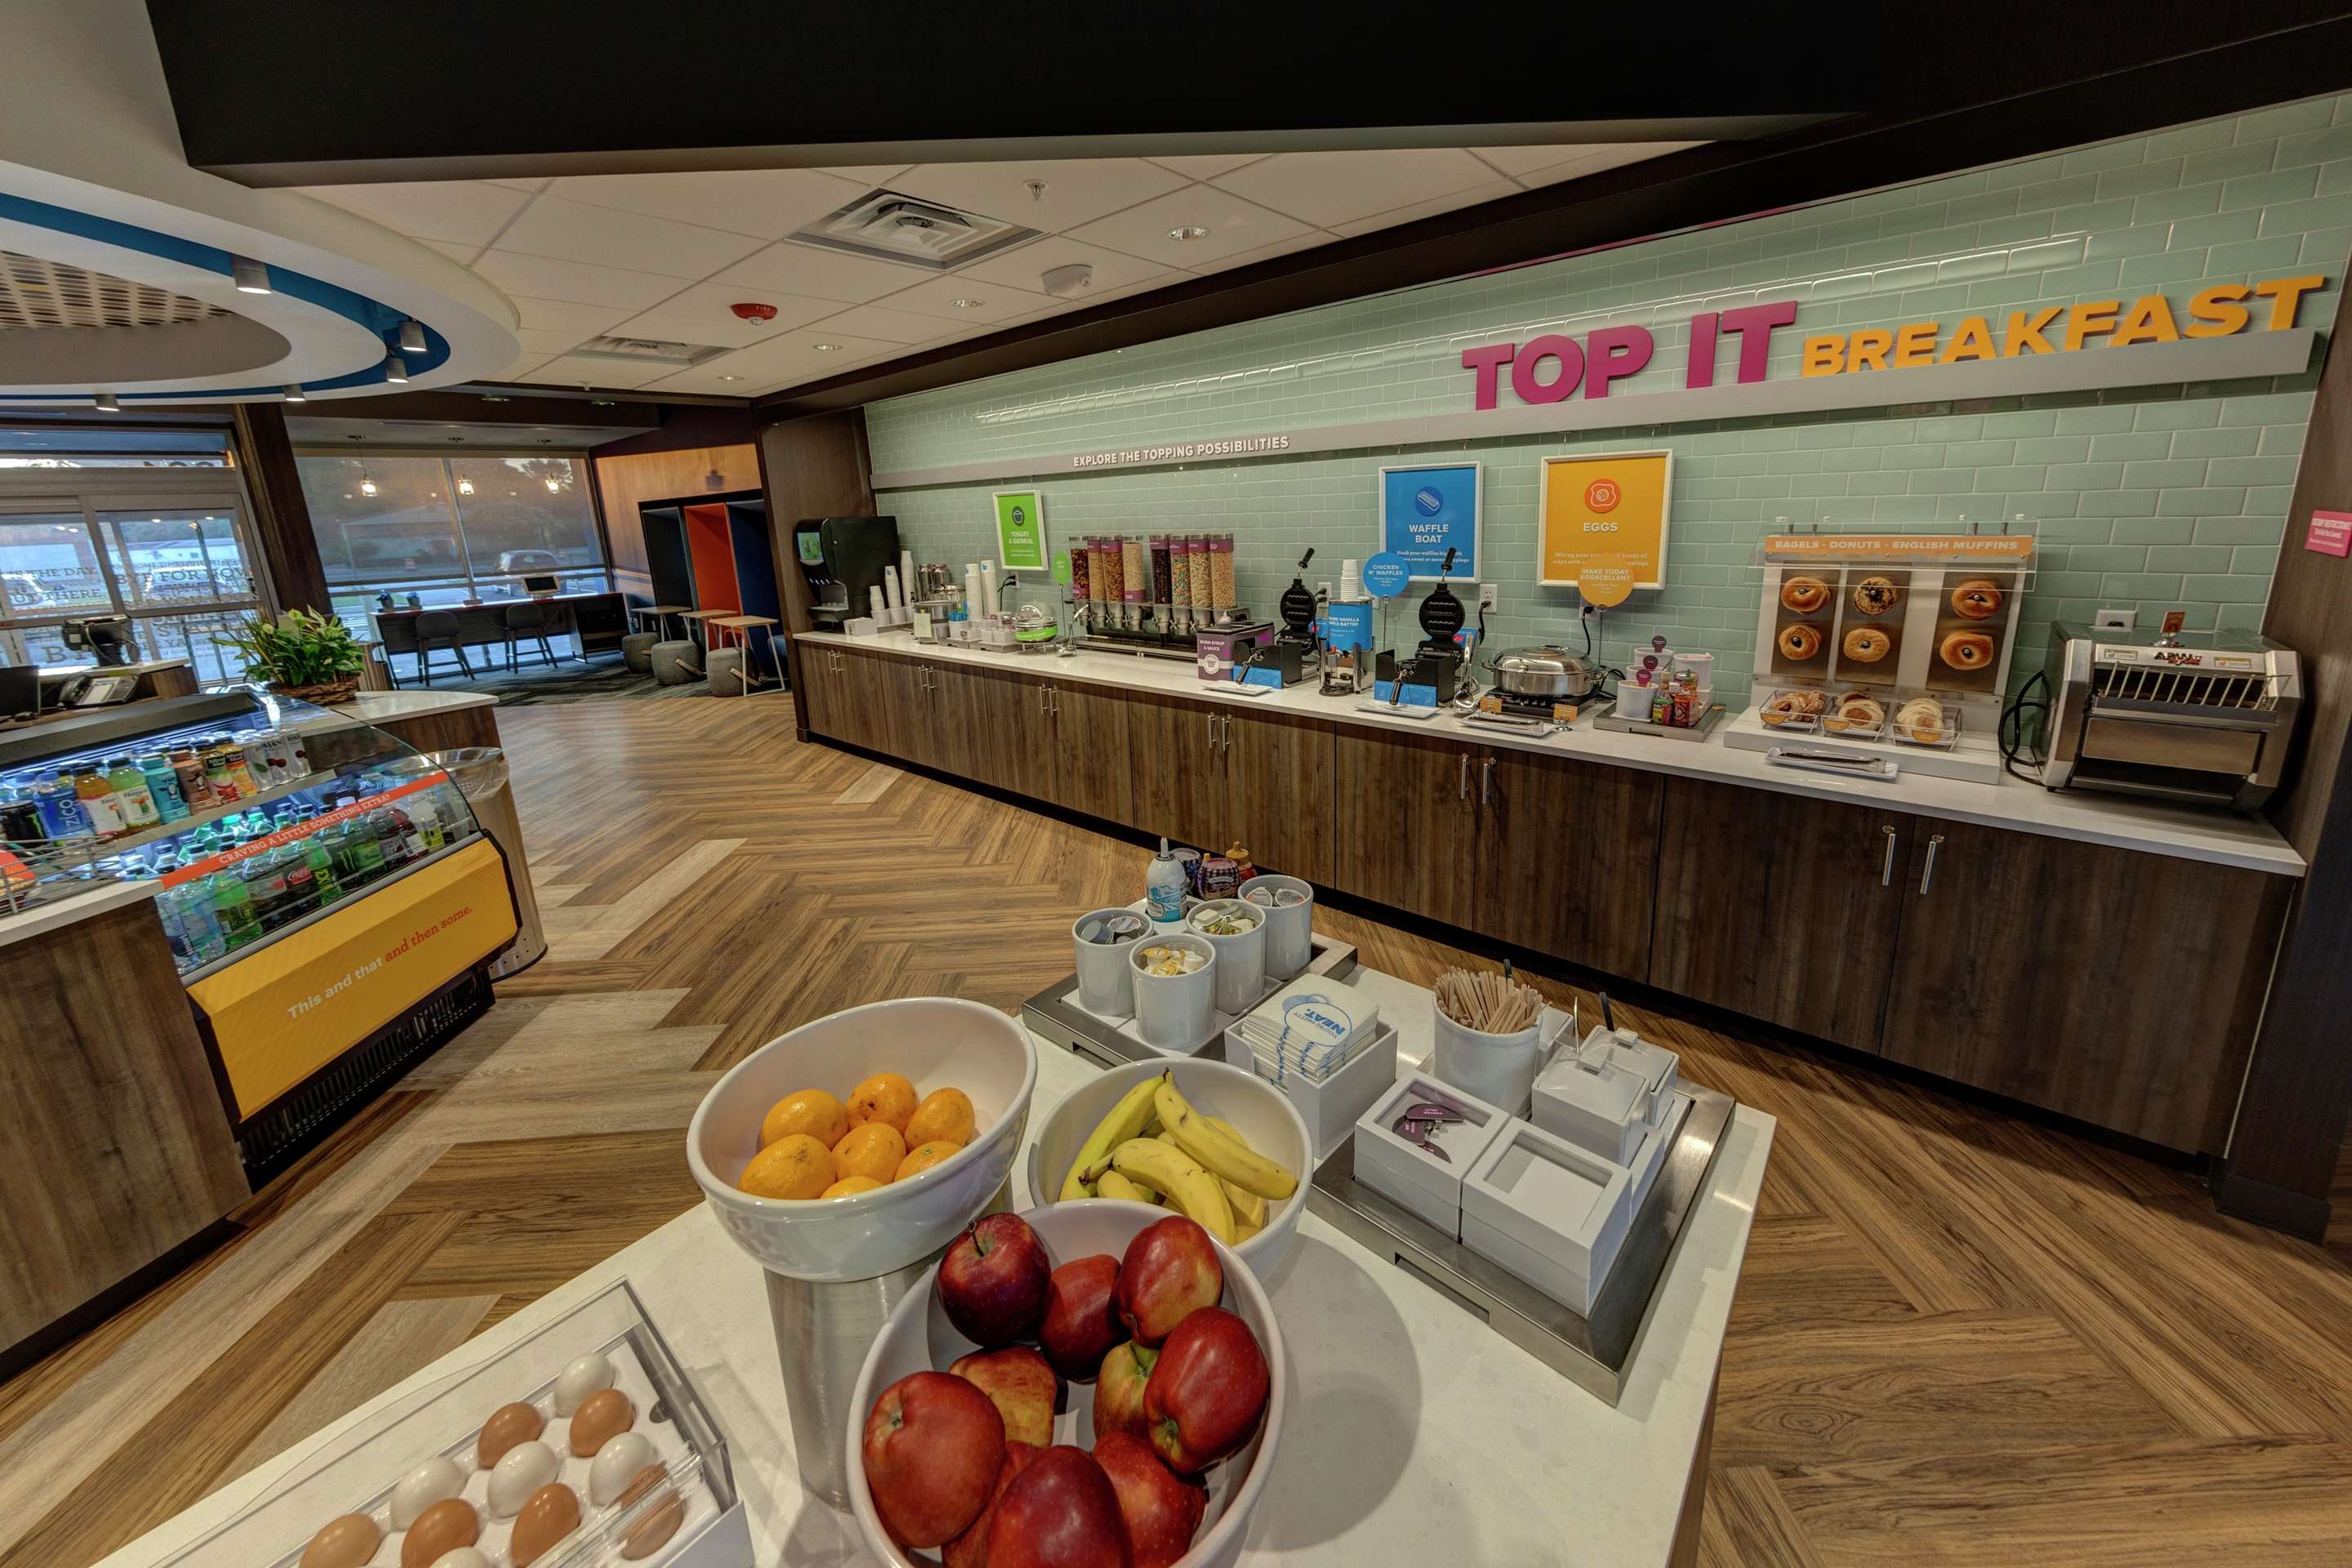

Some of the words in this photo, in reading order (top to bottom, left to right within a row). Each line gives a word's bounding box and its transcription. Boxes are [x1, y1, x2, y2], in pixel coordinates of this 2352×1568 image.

[1462, 325, 1654, 411] TOP
[1686, 301, 1797, 390] IT
[1802, 274, 2325, 378] BREAKFAST
[1073, 453, 1117, 467] EXPLORE
[1120, 451, 1141, 462] THE
[1143, 446, 1194, 461] TOPPING
[1197, 436, 1290, 456] POSSIBILITIES
[1409, 523, 1450, 532] WAFFLE
[1583, 522, 1619, 532] EGGS
[1415, 535, 1442, 543] BOAT
[1775, 541, 1819, 549] BAGELS
[1829, 541, 1881, 549] DONUTS
[1891, 541, 1949, 550] ENGLISH
[1953, 541, 2019, 550] MUFFINS
[159, 570, 198, 582] FOR
[219, 840, 267, 863] CRAVING
[269, 836, 278, 844] A
[278, 824, 310, 841] LITTLE
[310, 805, 363, 829] SOMETHING
[361, 794, 392, 809] EXTRA?
[287, 994, 322, 1020] This
[325, 974, 352, 999] and
[354, 956, 384, 980] that
[385, 939, 410, 963] and
[411, 926, 439, 947] then
[440, 906, 473, 929] some.
[1304, 1009, 1346, 1036] NEAT.
